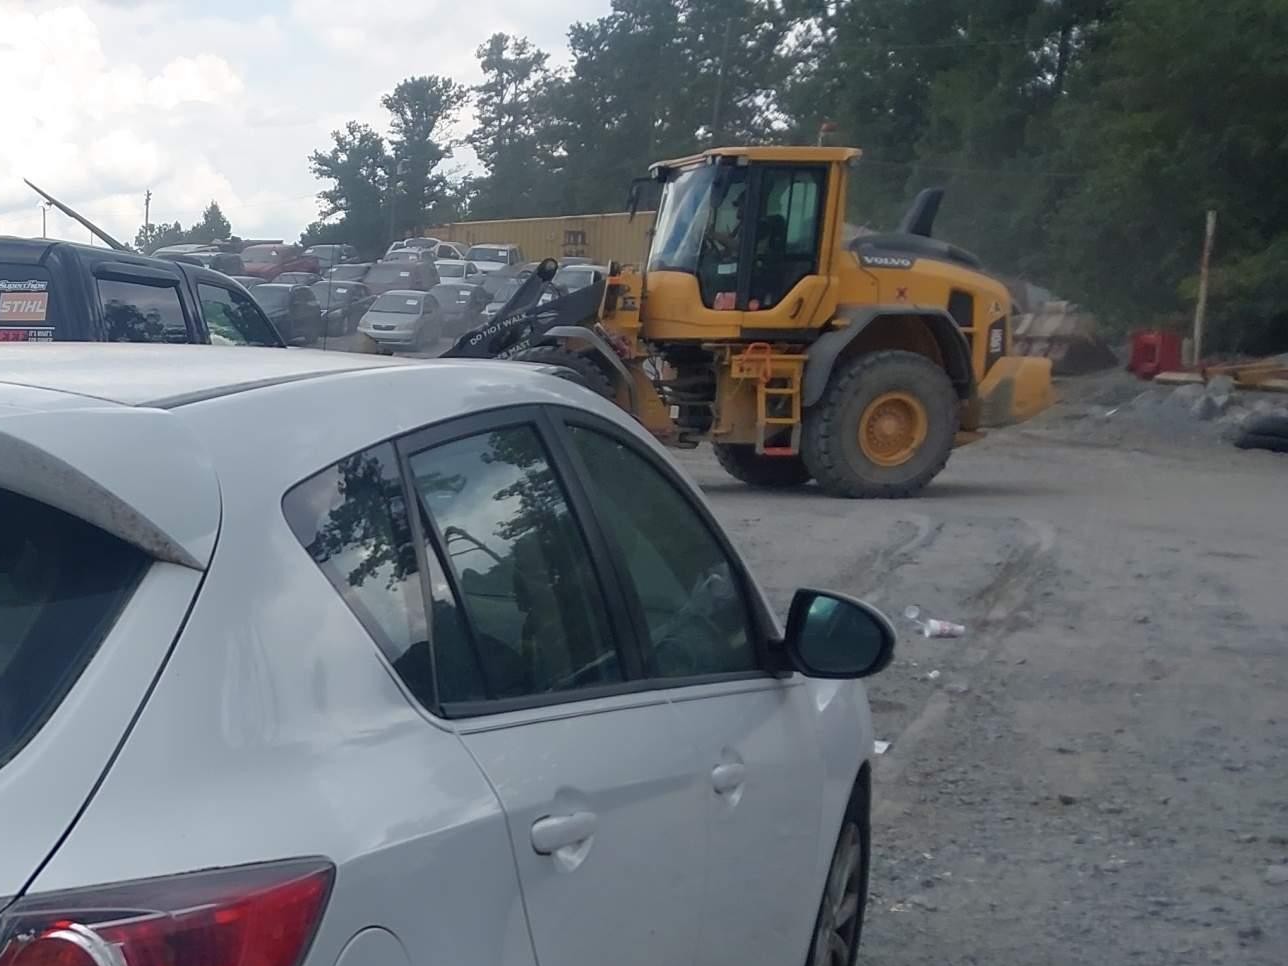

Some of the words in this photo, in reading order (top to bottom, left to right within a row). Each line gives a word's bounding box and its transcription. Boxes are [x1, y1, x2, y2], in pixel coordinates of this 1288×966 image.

[863, 256, 911, 266] VOLVO
[0, 300, 46, 312] STIHL
[502, 312, 528, 328] WALK
